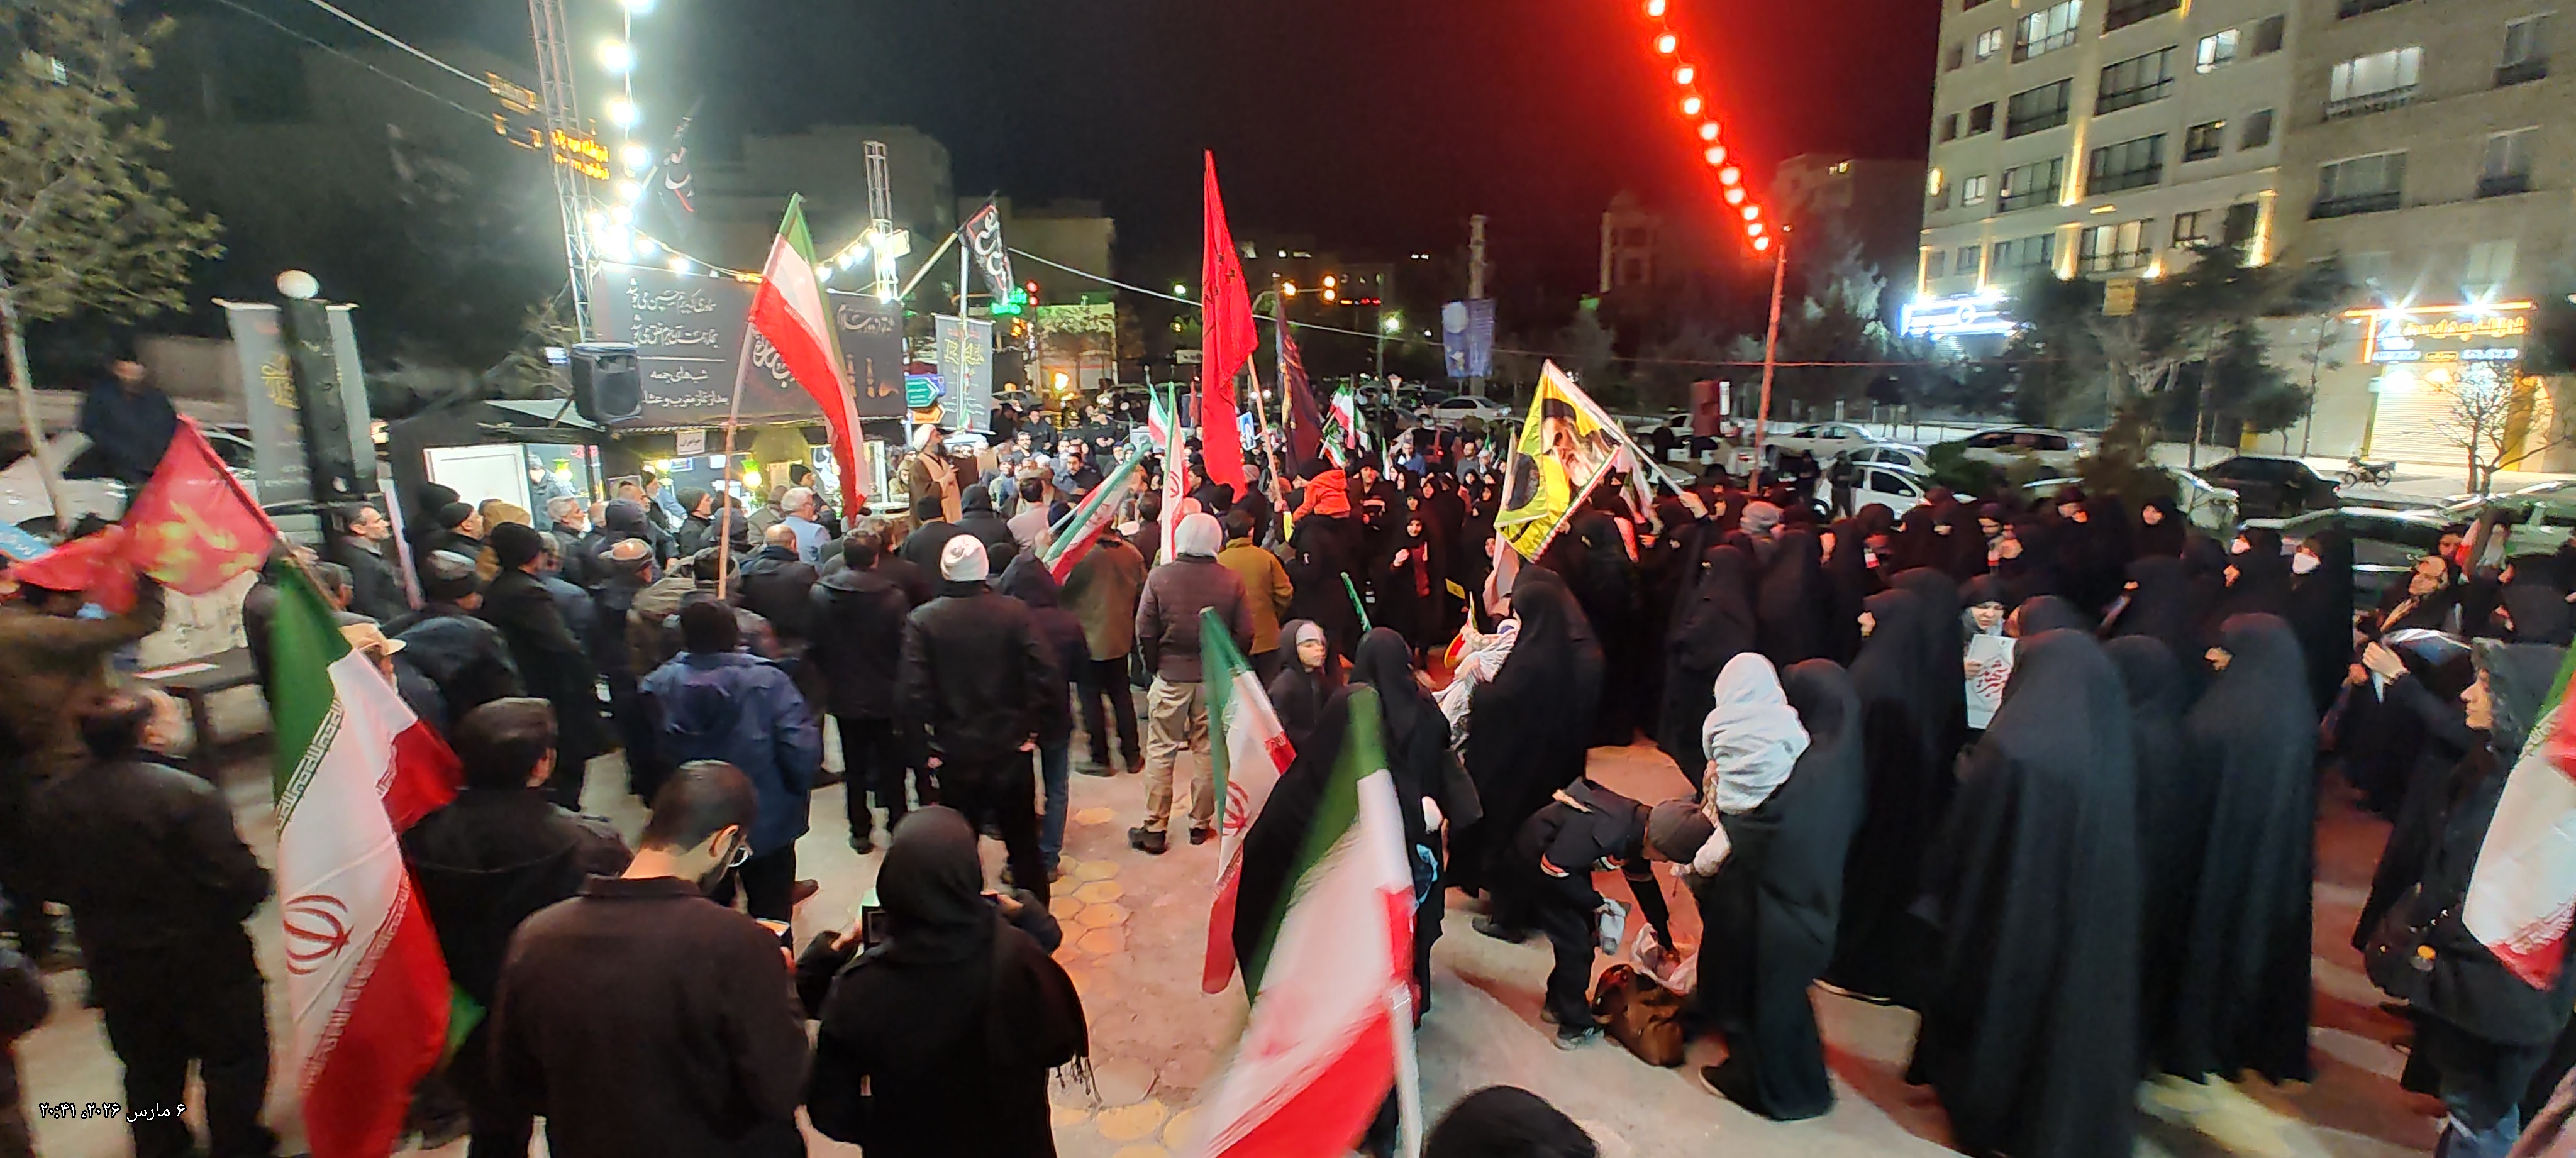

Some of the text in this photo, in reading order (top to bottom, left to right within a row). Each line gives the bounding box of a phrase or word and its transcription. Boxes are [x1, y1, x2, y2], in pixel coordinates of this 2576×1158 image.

[648, 290, 679, 313] حسین
[649, 370, 672, 384] جمعه
[670, 394, 696, 408] مغرب
[694, 390, 708, 407] نماز
[707, 390, 716, 406] از
[714, 394, 730, 405] بعد
